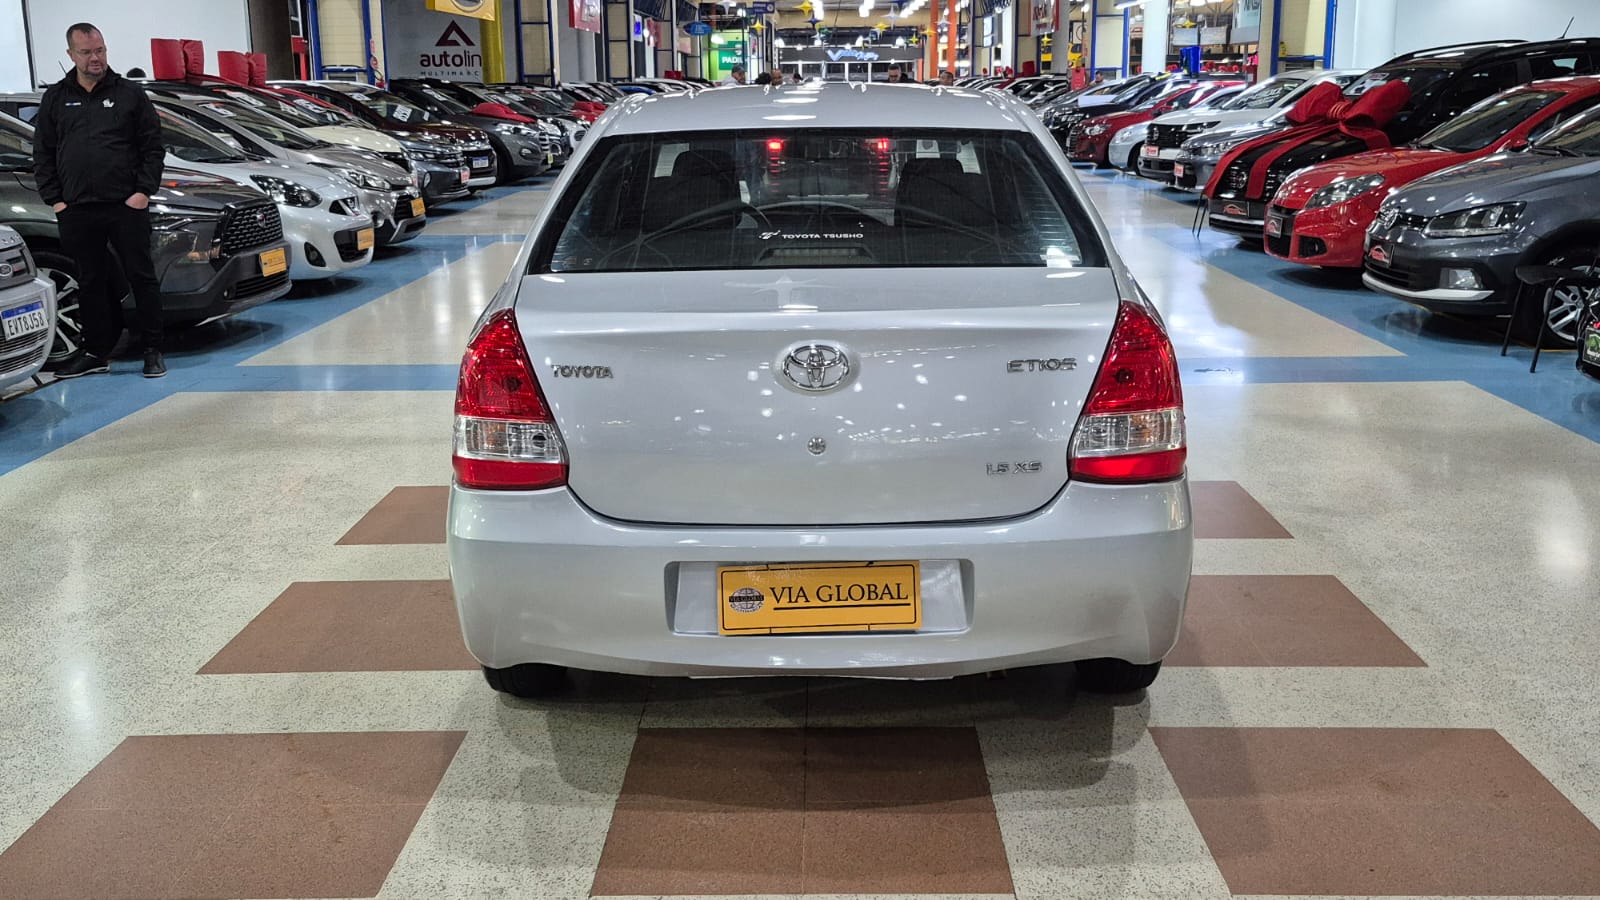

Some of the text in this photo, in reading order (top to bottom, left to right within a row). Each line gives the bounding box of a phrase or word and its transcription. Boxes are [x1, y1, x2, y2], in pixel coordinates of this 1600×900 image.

[420, 50, 482, 67] autolin
[551, 364, 614, 379] TOYOTA
[1007, 358, 1077, 373] ETIOS
[1013, 461, 1042, 474] XS
[769, 582, 909, 604] VIA GLOBAL
